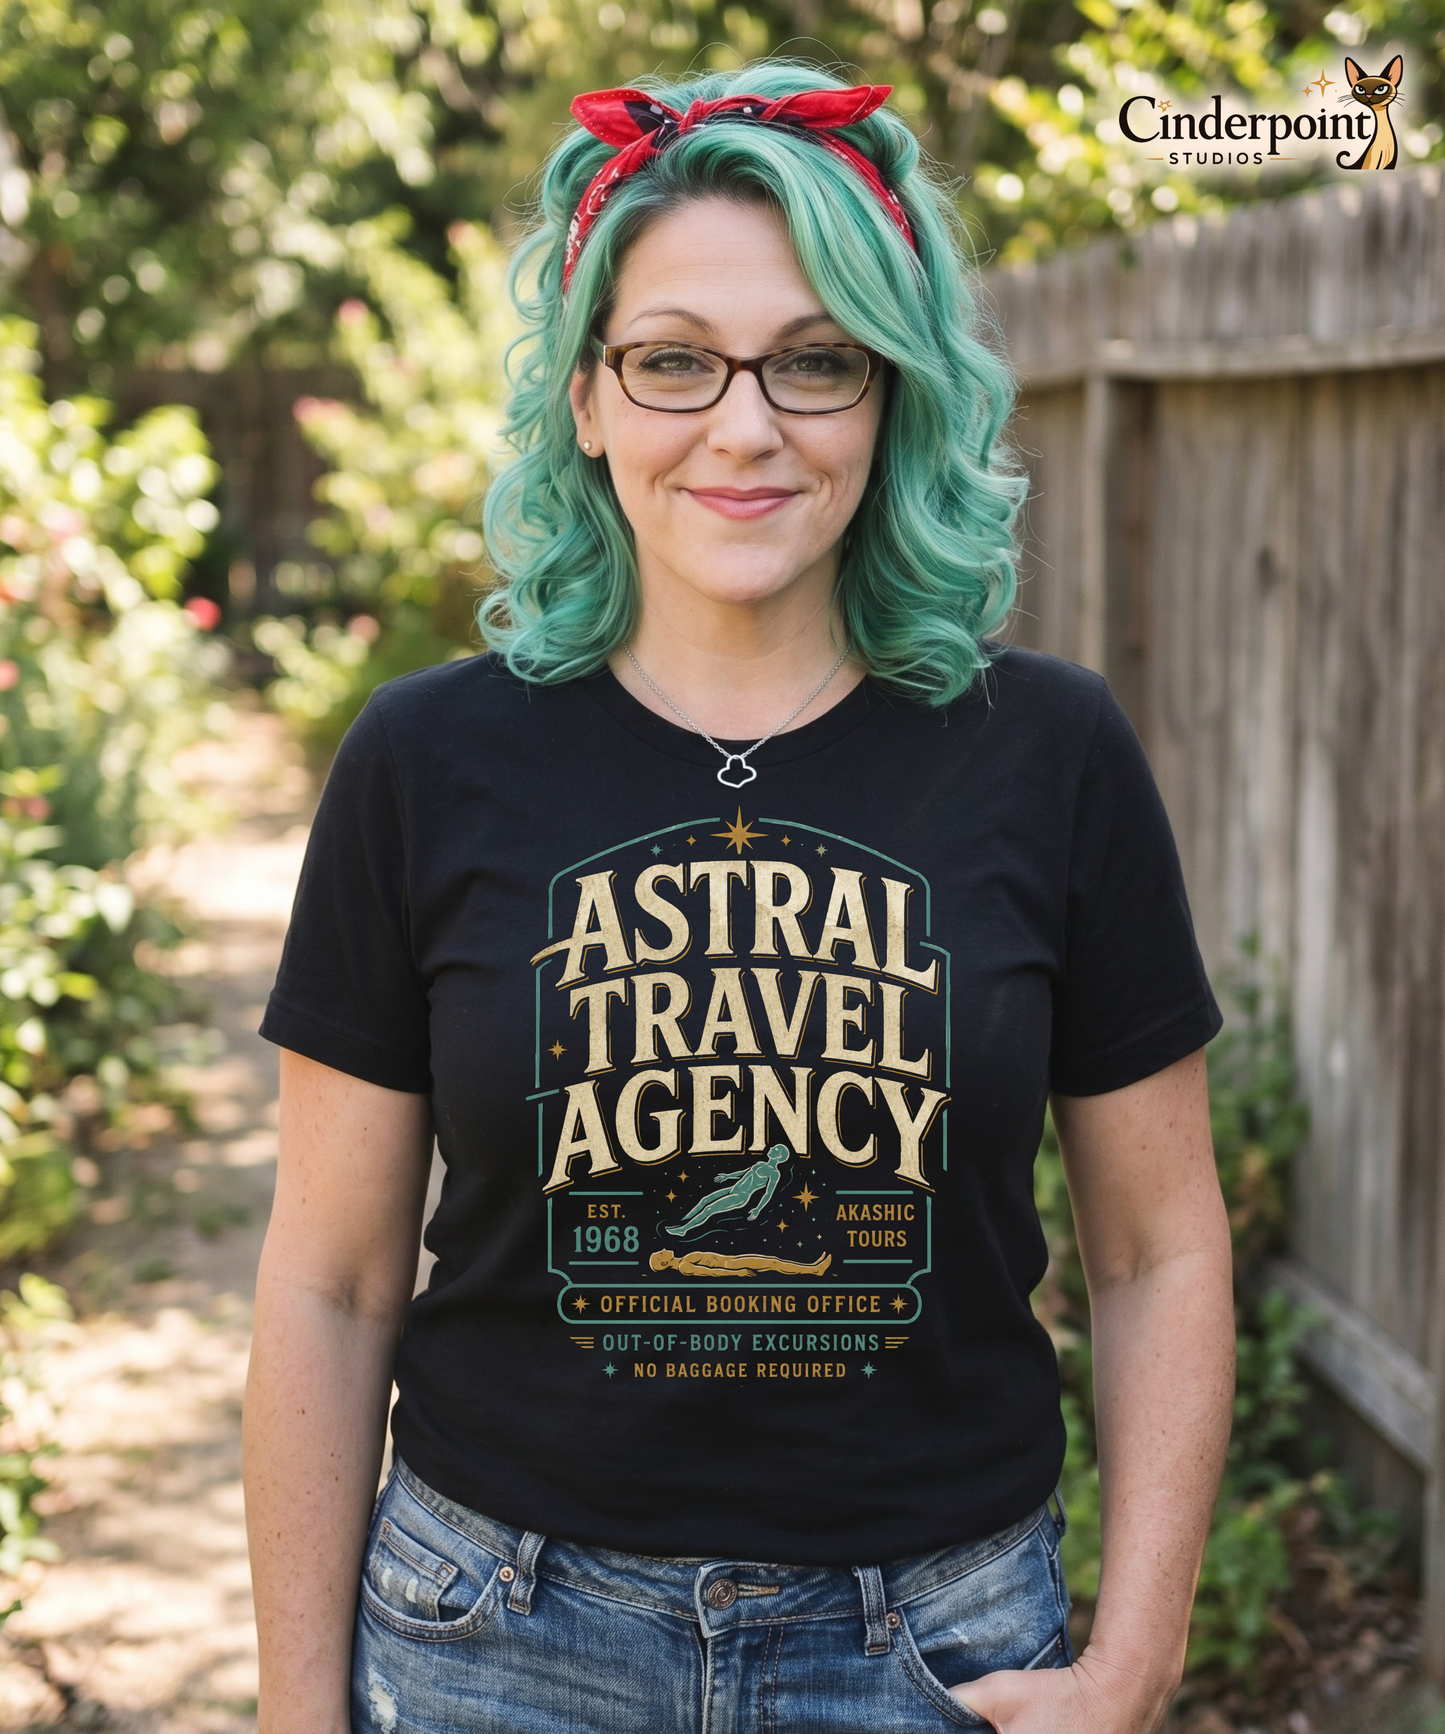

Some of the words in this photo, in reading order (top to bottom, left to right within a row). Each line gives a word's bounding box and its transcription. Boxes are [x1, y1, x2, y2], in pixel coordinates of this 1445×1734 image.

[530, 860, 939, 995] ASTRAL
[569, 967, 932, 1080] TRAVEL
[542, 1064, 951, 1193] AGENCY
[587, 1204, 626, 1219] EST.
[835, 1204, 915, 1222] AKASHIC
[573, 1225, 640, 1254] 1968
[847, 1230, 907, 1248] TOURS
[600, 1295, 696, 1313] OFFICIAL
[706, 1295, 796, 1313] BOOKING
[807, 1295, 881, 1313] OFFICE
[602, 1334, 742, 1352] OUT-OF-BODY
[752, 1334, 879, 1352] EXCURSIONS
[634, 1363, 657, 1378] NO
[666, 1363, 748, 1378] BAGGAGE
[756, 1363, 847, 1379] REQUIRED
